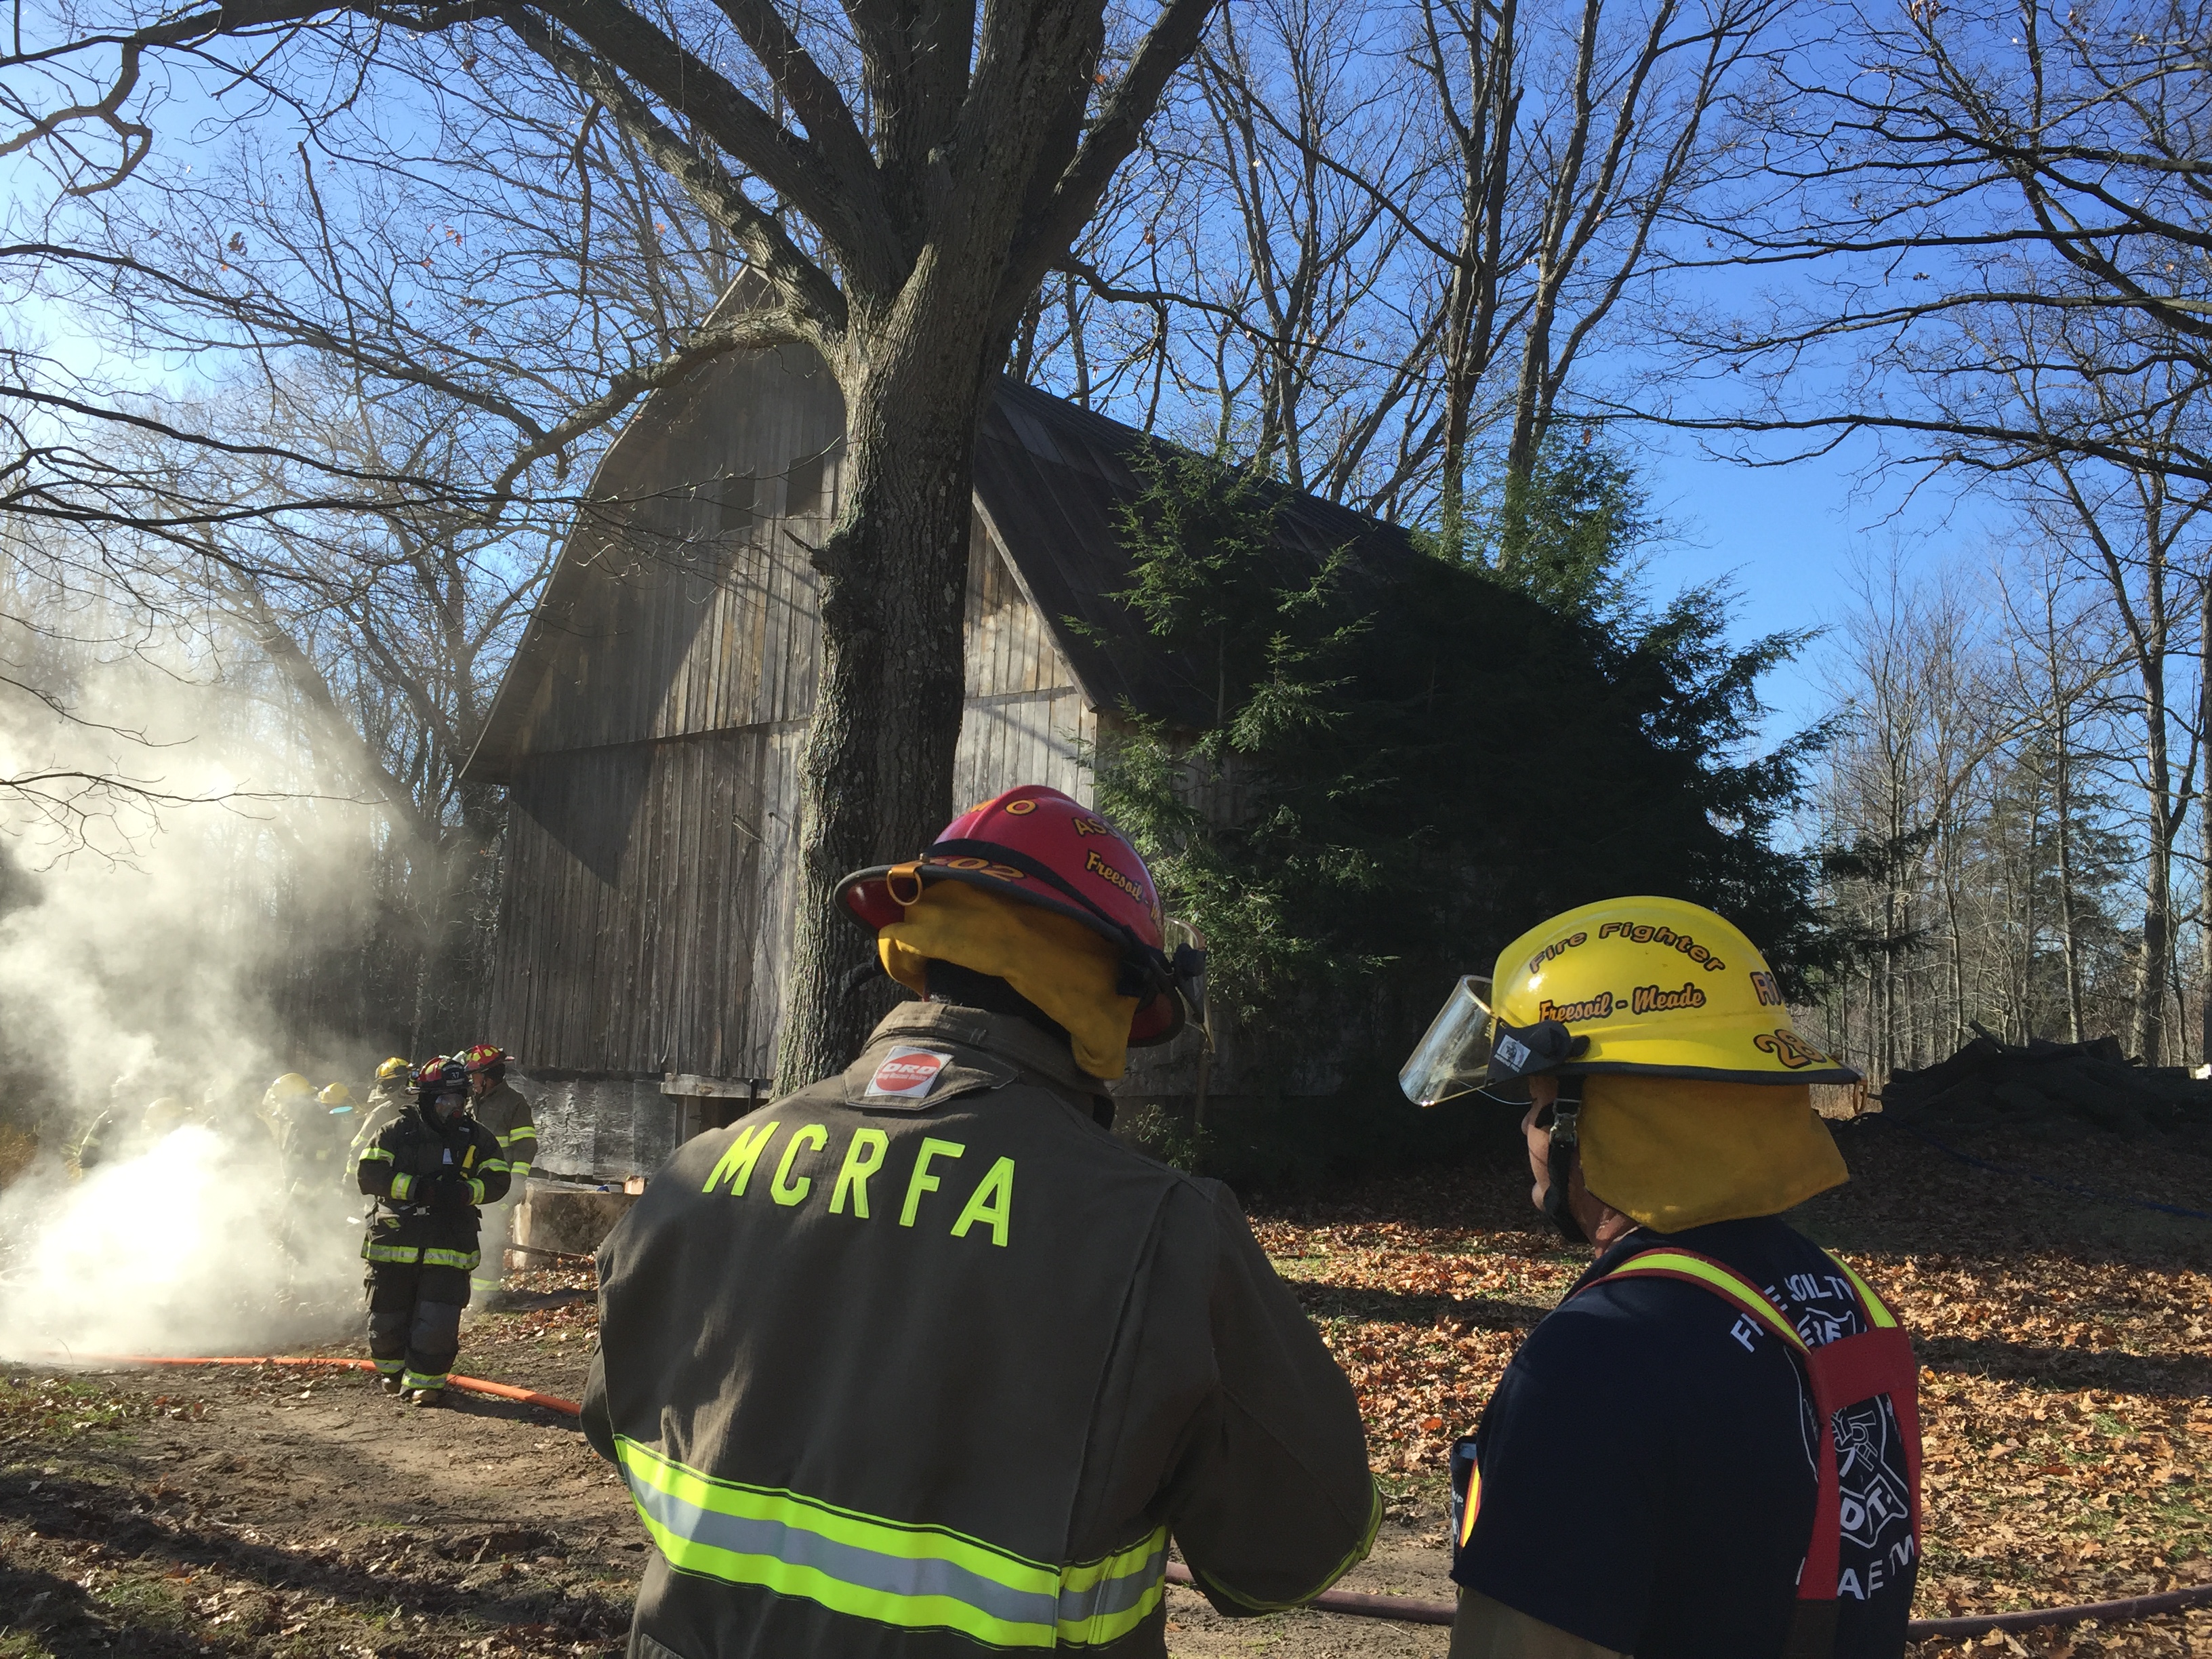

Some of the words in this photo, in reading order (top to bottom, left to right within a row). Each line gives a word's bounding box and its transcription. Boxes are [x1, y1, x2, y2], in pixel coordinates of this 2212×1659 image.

[1085, 851, 1143, 903] Freesoil
[1529, 932, 1588, 974] Fire
[1598, 922, 1726, 972] Fighter
[1538, 991, 1613, 1024] Freesoil
[1631, 981, 1706, 1015] Meade
[701, 1121, 1016, 1248] MCRFA
